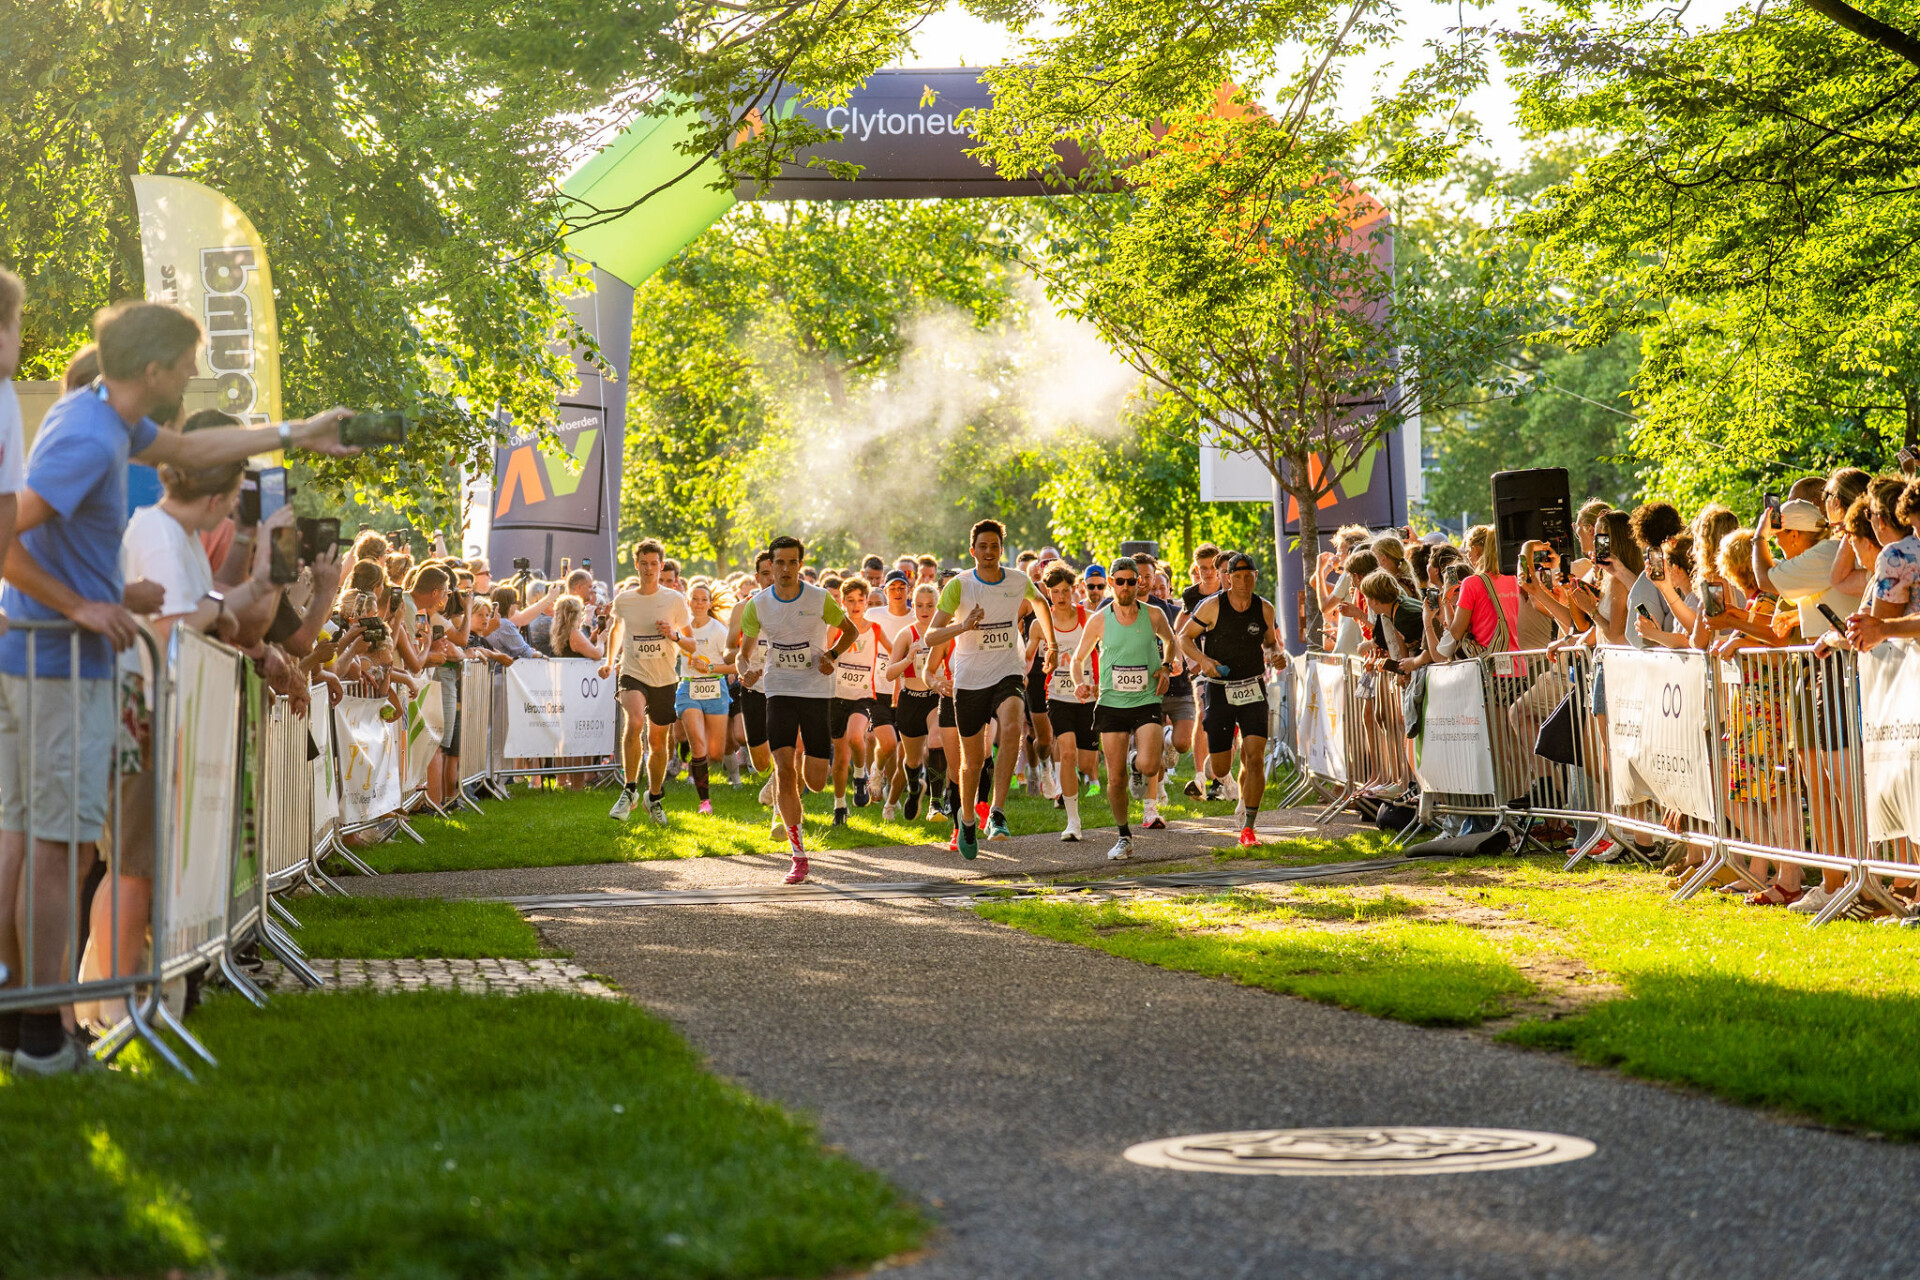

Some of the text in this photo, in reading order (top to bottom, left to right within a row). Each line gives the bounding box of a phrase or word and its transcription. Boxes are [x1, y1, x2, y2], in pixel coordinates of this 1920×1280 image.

[555, 415, 599, 434] Woerden
[983, 632, 1009, 644] 2010
[638, 644, 661, 653] 4004
[778, 653, 805, 663] 5119
[841, 671, 865, 682] 4037
[1117, 675, 1143, 685] 2043
[694, 685, 716, 694] 3002
[907, 690, 928, 698] NIKE
[1232, 688, 1256, 700] 4021
